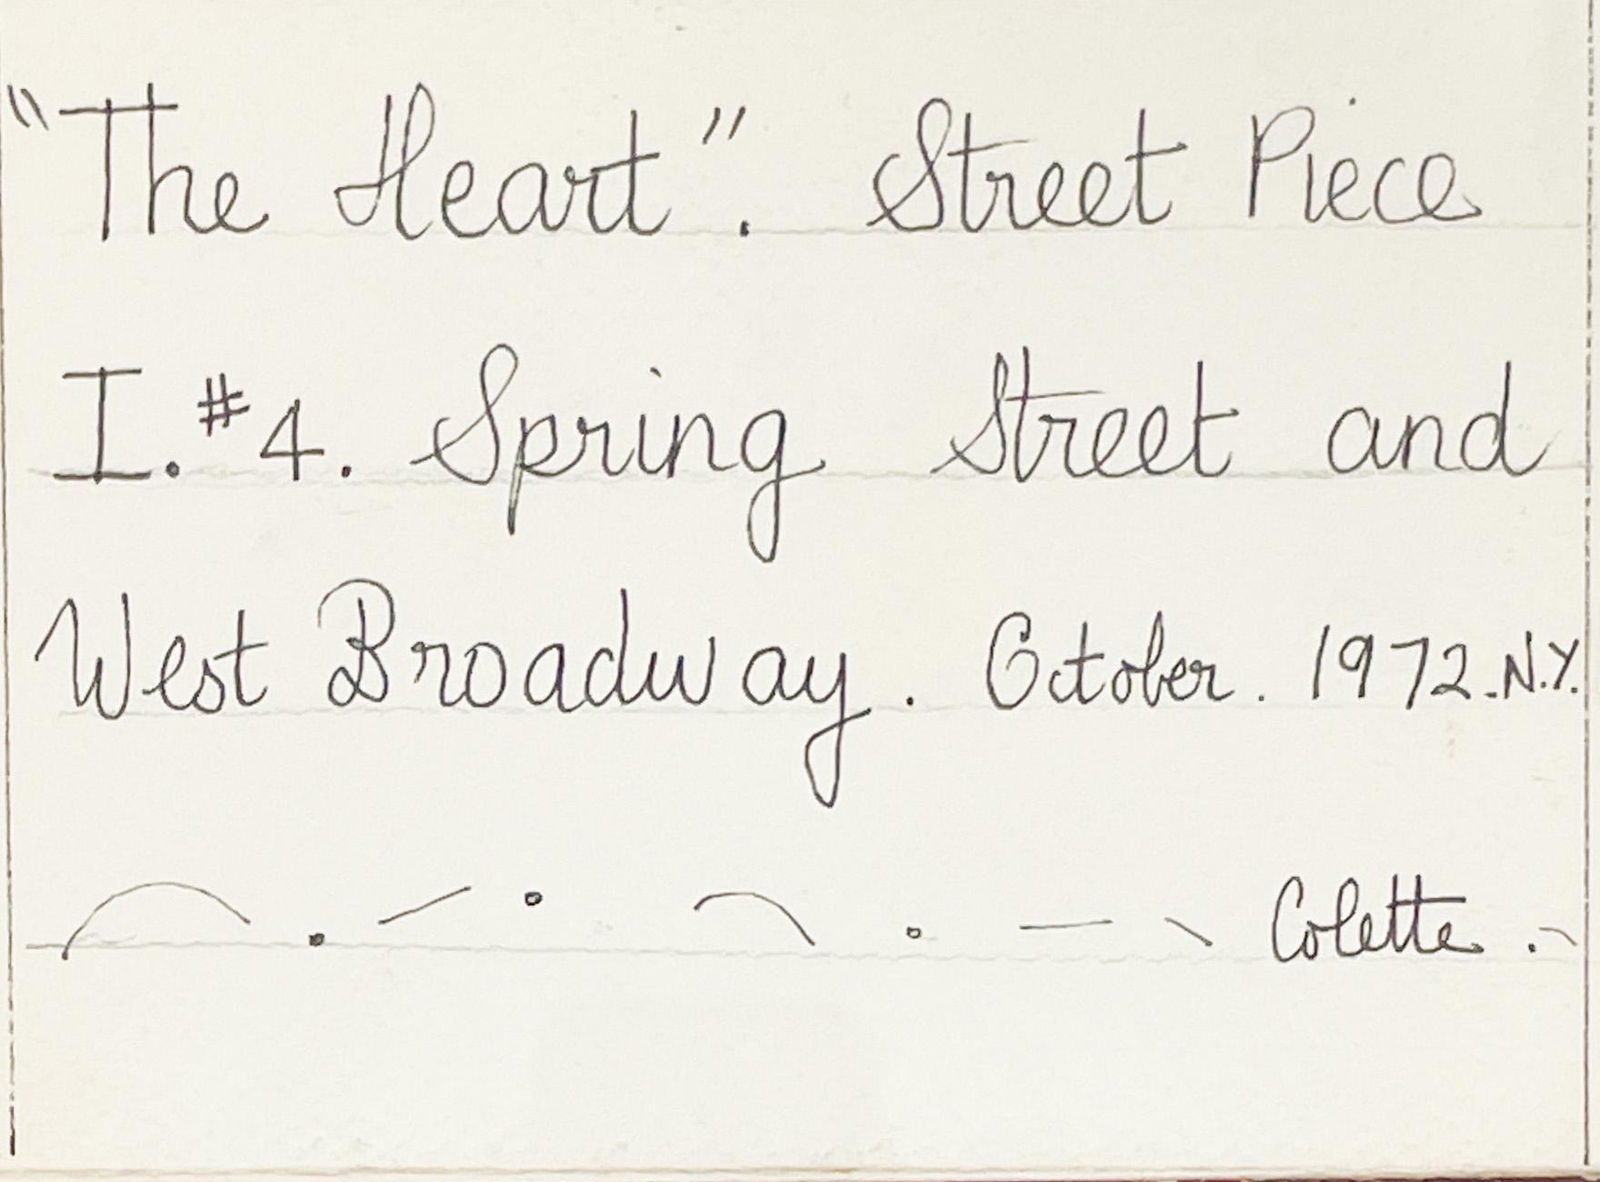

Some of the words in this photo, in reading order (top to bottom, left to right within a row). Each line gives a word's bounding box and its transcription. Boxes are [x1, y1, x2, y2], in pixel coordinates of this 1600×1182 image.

[867, 98, 1188, 232] Street
[1250, 99, 1482, 222] Piece
[411, 344, 826, 562] Spring
[930, 346, 1239, 482] Street
[1328, 361, 1554, 475] and
[35, 592, 268, 719] West
[1273, 874, 1485, 962] Colette
